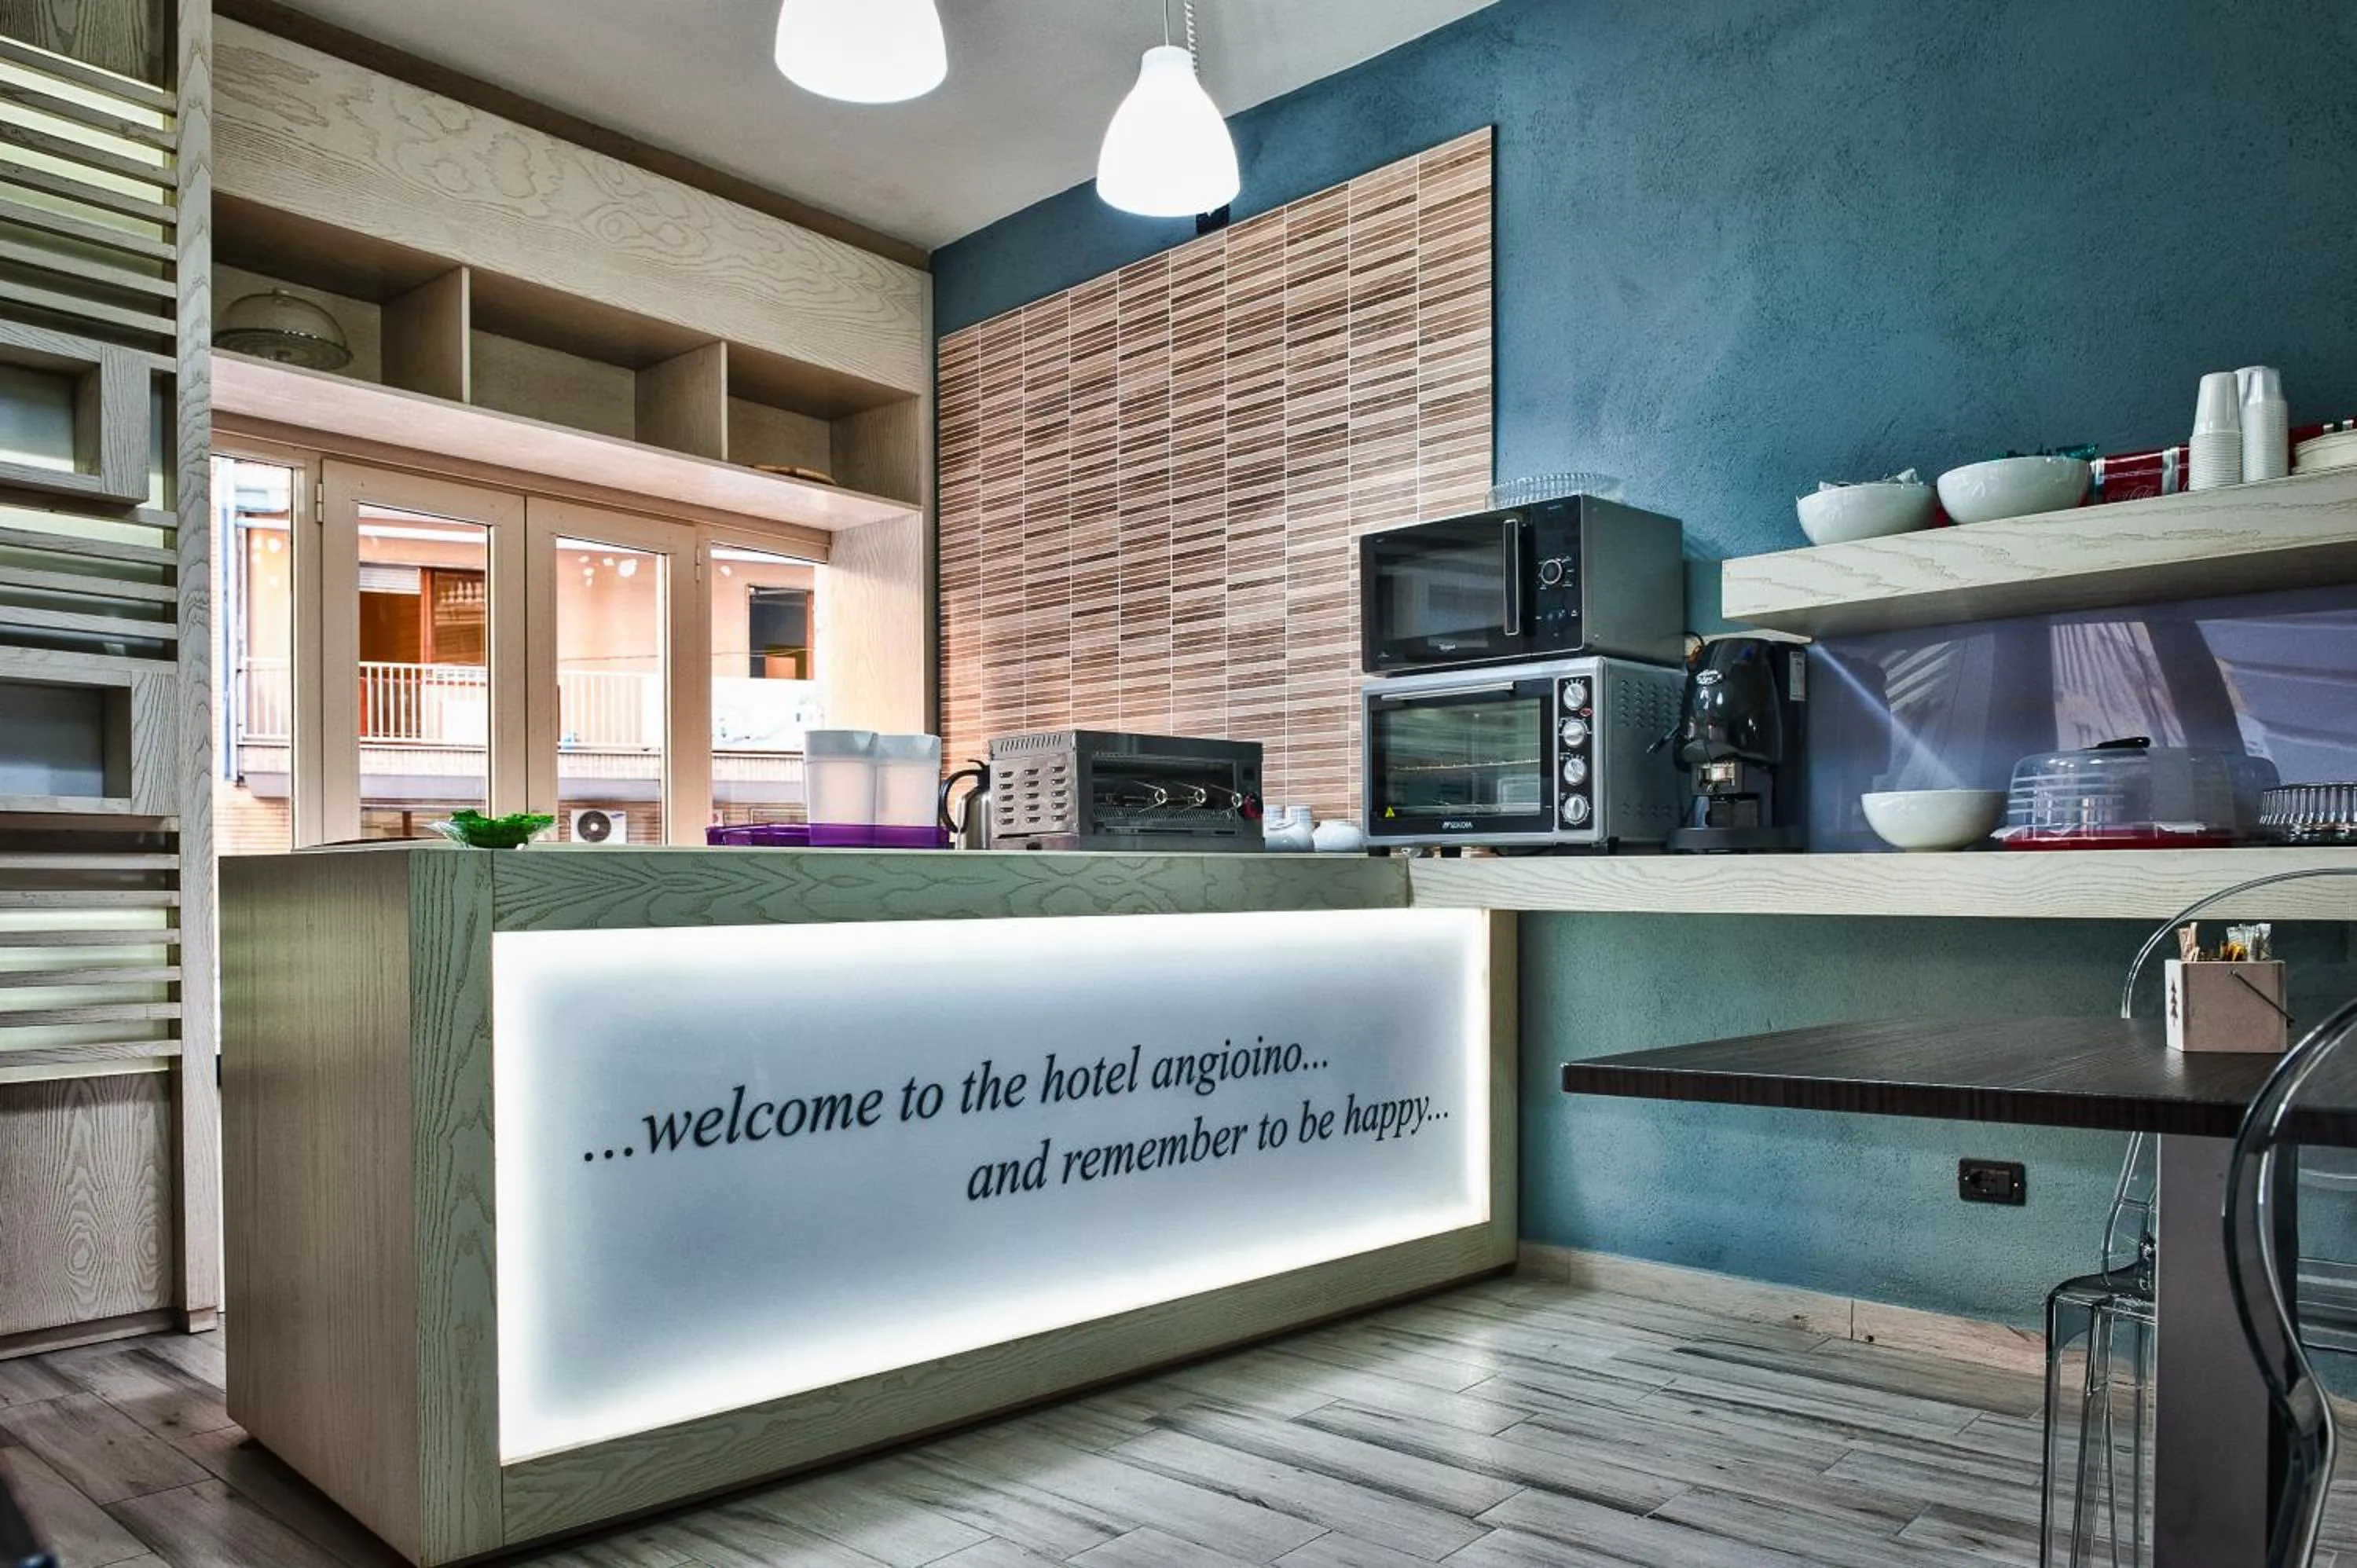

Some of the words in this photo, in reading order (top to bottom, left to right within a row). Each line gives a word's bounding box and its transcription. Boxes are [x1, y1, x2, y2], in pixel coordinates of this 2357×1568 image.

[584, 1084, 884, 1163] ...welcome
[900, 1076, 944, 1123] to
[960, 1060, 1027, 1115] the
[1039, 1044, 1142, 1105] hotel
[1151, 1035, 1329, 1097] angioino...
[966, 1138, 1051, 1201] and
[1061, 1115, 1248, 1185] remember
[1258, 1113, 1288, 1151] to
[1298, 1099, 1336, 1144] be
[1343, 1093, 1448, 1142] happy...
